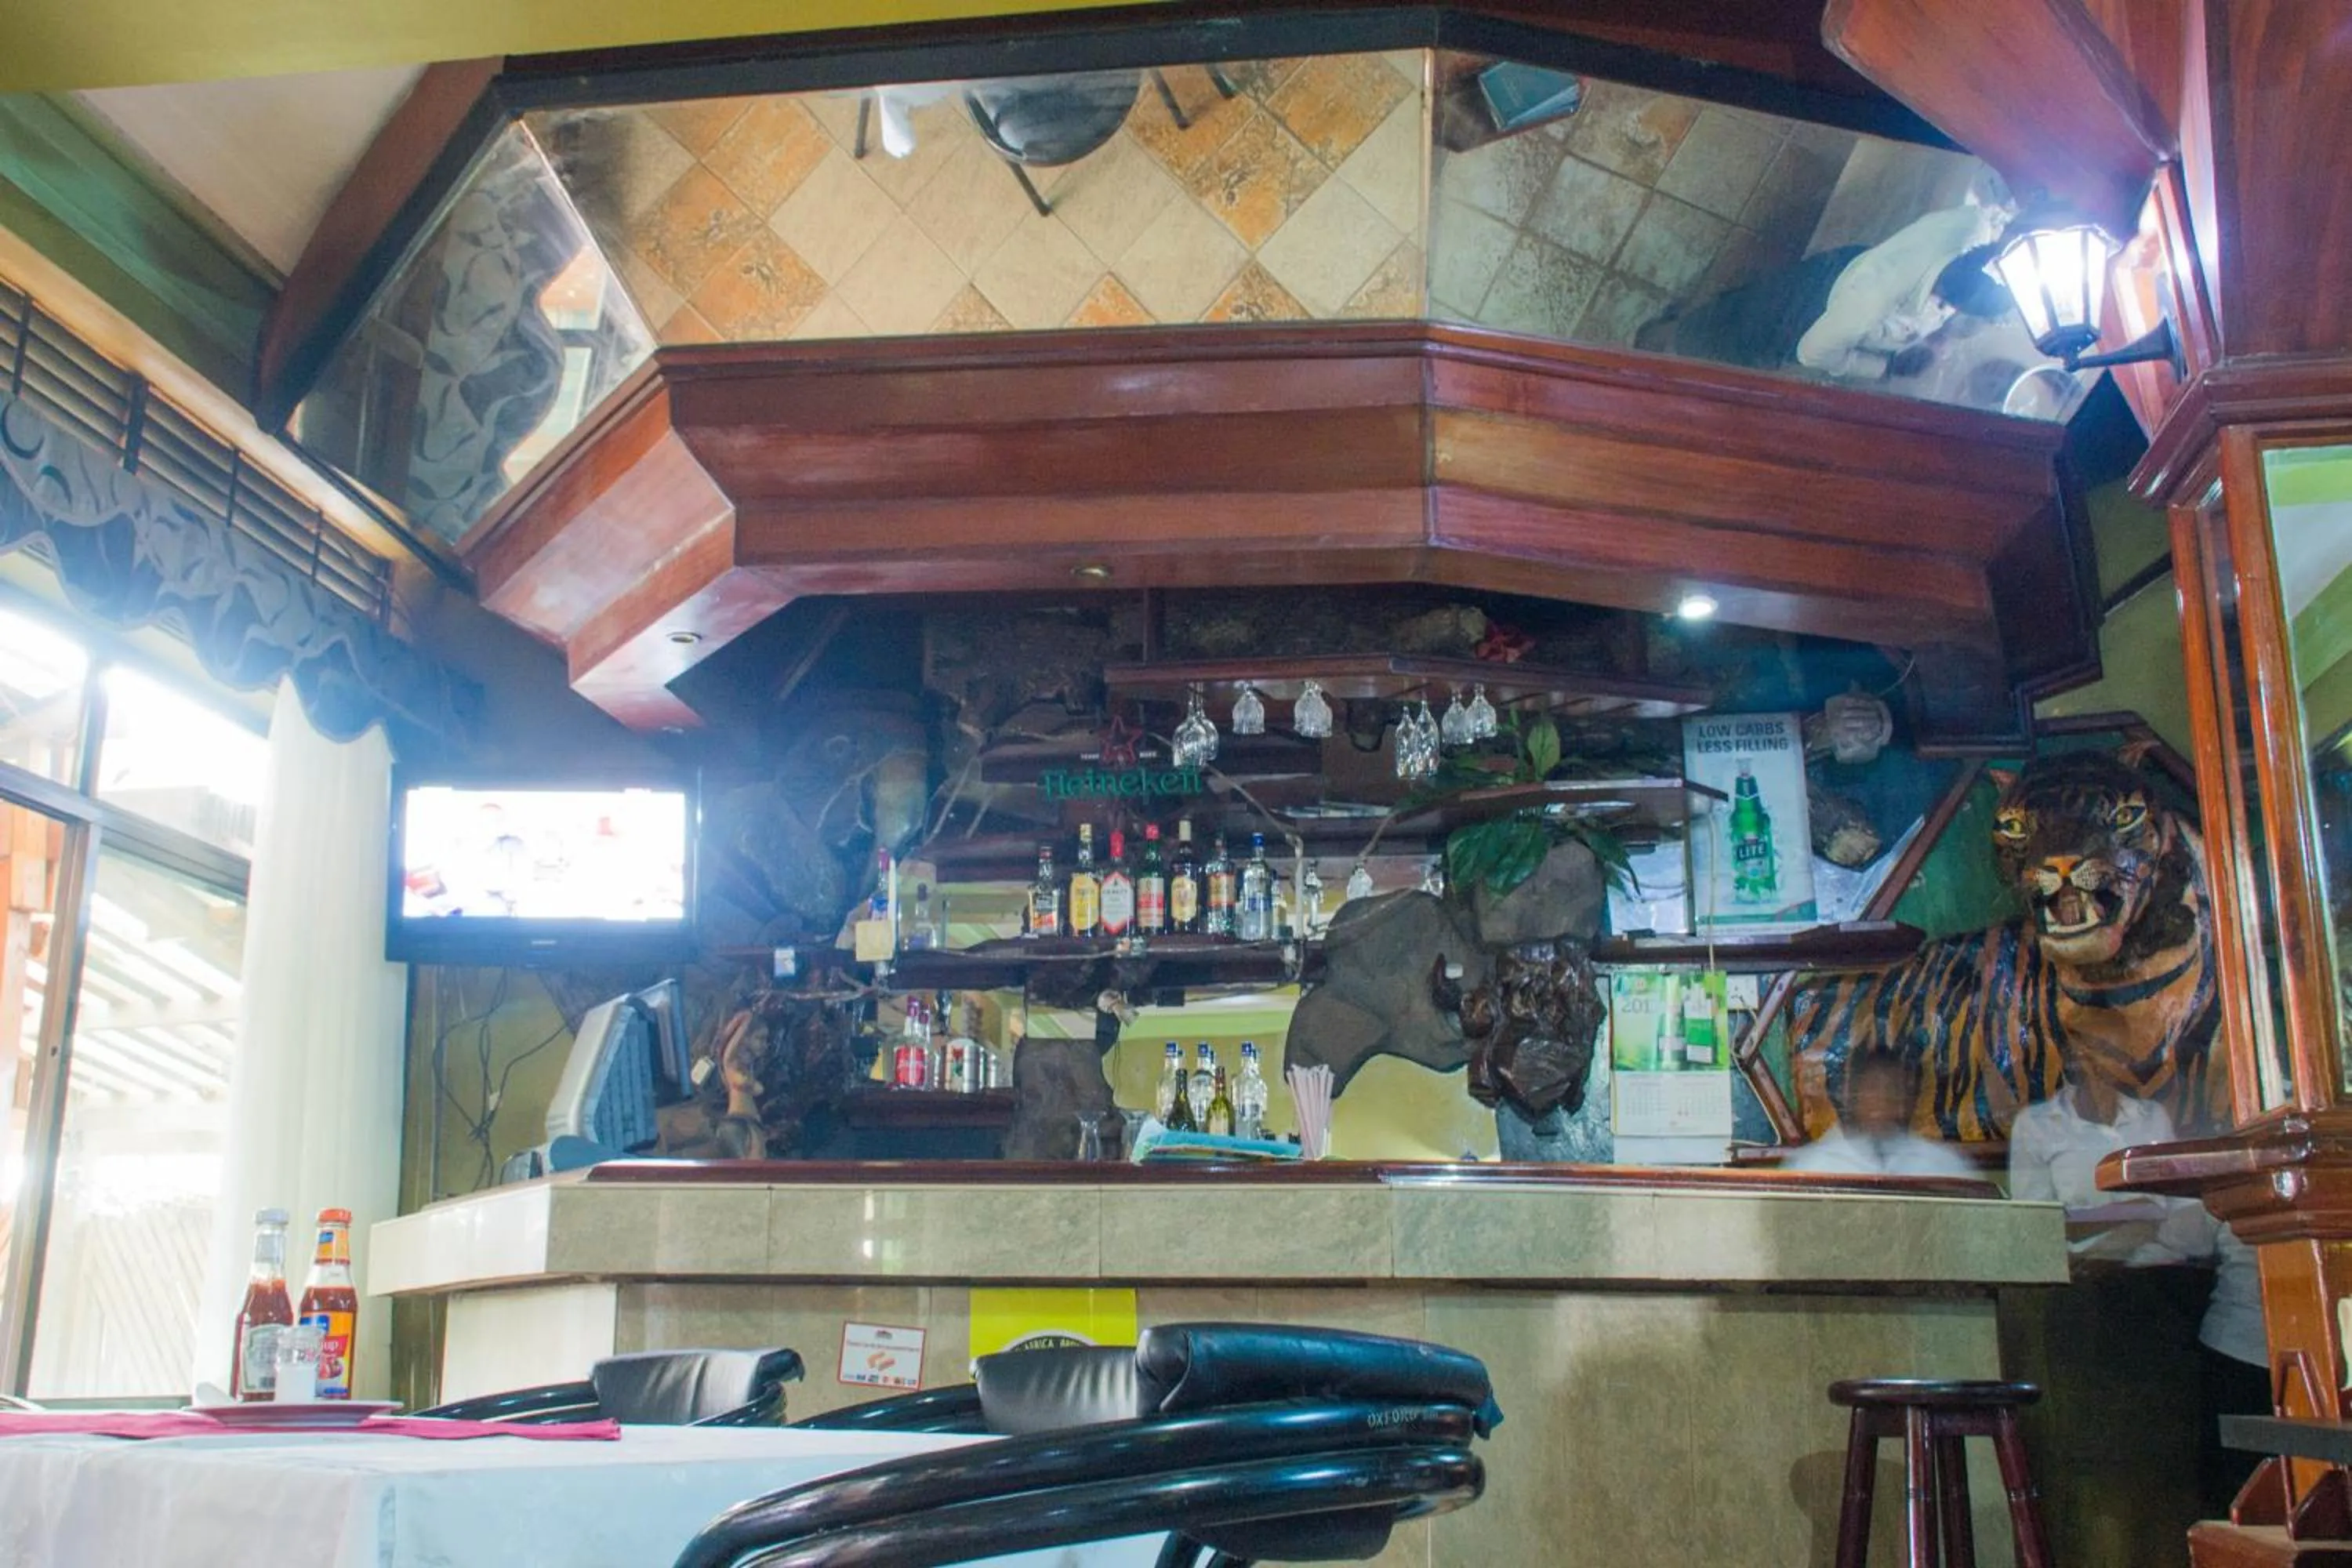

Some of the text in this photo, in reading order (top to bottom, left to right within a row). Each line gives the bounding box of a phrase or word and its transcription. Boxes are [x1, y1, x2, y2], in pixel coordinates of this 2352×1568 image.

[1698, 724, 1731, 738] LOW
[1697, 737, 1788, 753] LESS FILLING
[1041, 765, 1203, 801] Heineken
[1738, 843, 1764, 859] LITE
